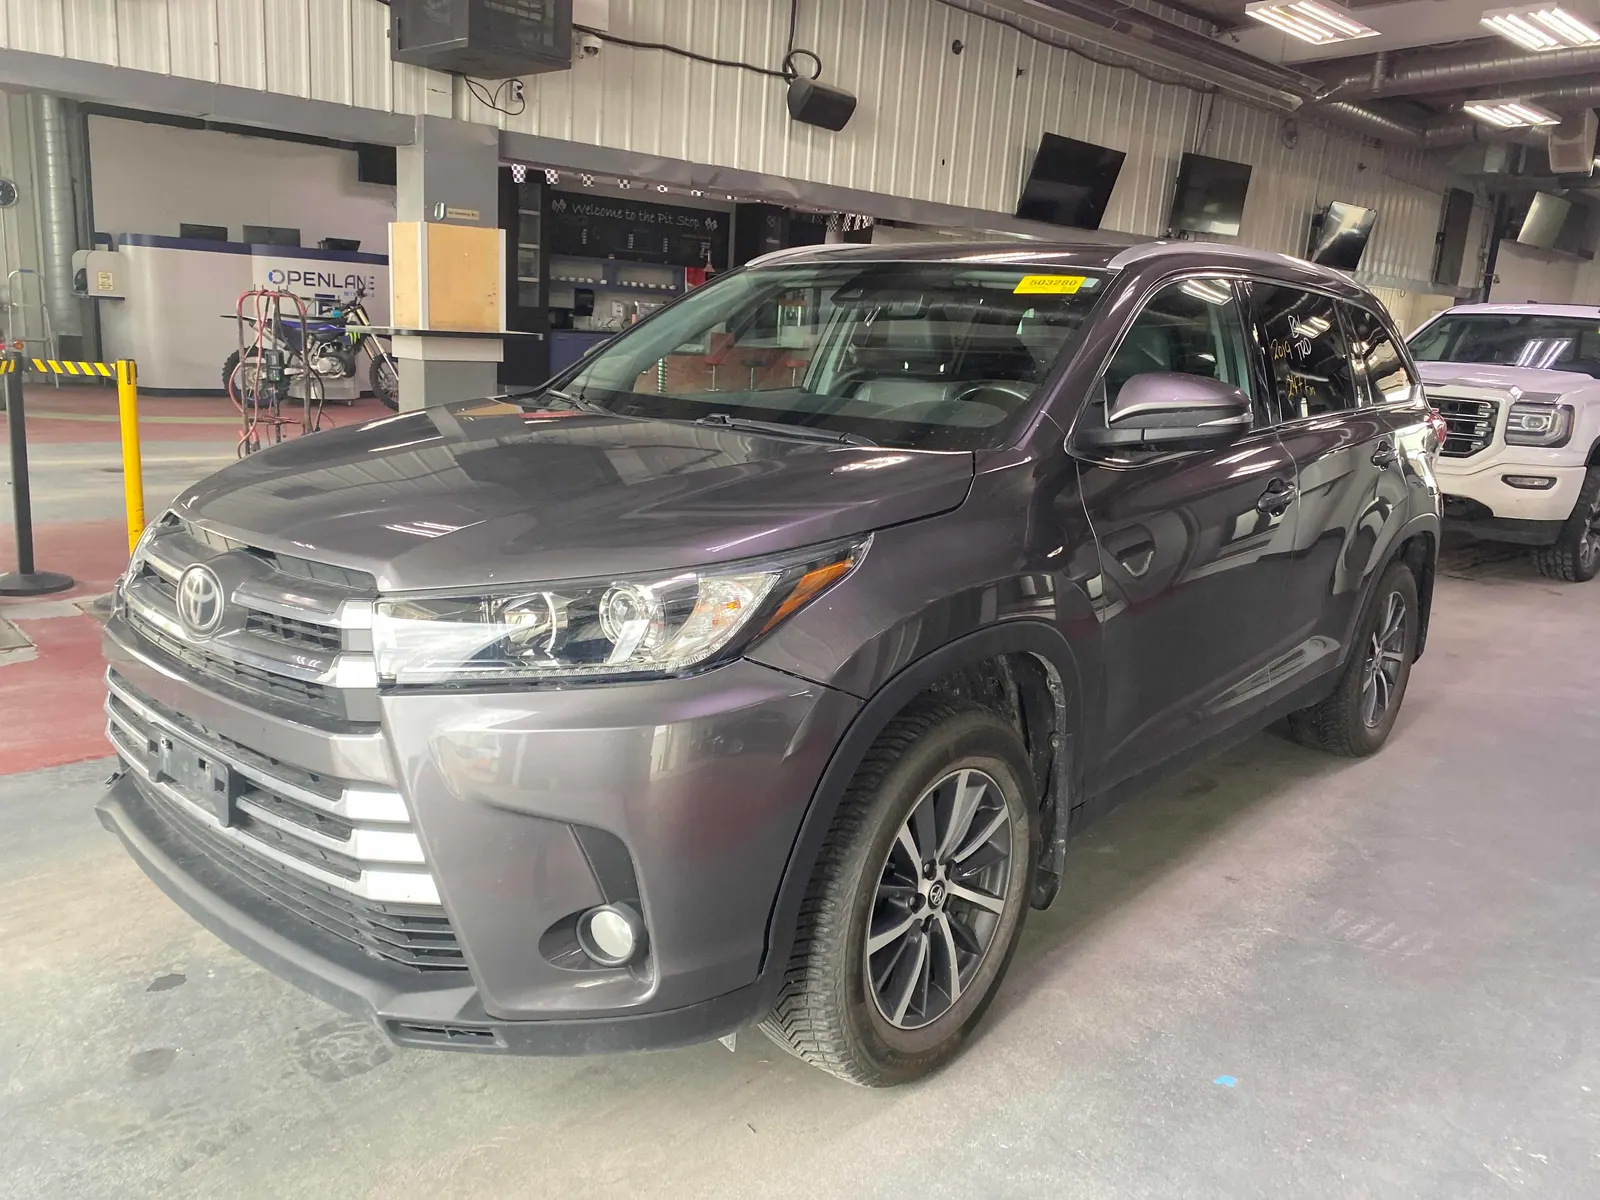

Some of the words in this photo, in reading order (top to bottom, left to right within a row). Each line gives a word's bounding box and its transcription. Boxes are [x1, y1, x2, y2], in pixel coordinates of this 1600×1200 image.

[572, 202, 623, 219] Welcome
[625, 208, 636, 221] to
[638, 208, 655, 223] the
[658, 211, 674, 225] Pit
[676, 214, 700, 230] Stop
[268, 269, 375, 291] OPENLANE
[1270, 338, 1293, 361] 2019
[1294, 337, 1312, 361] TRD
